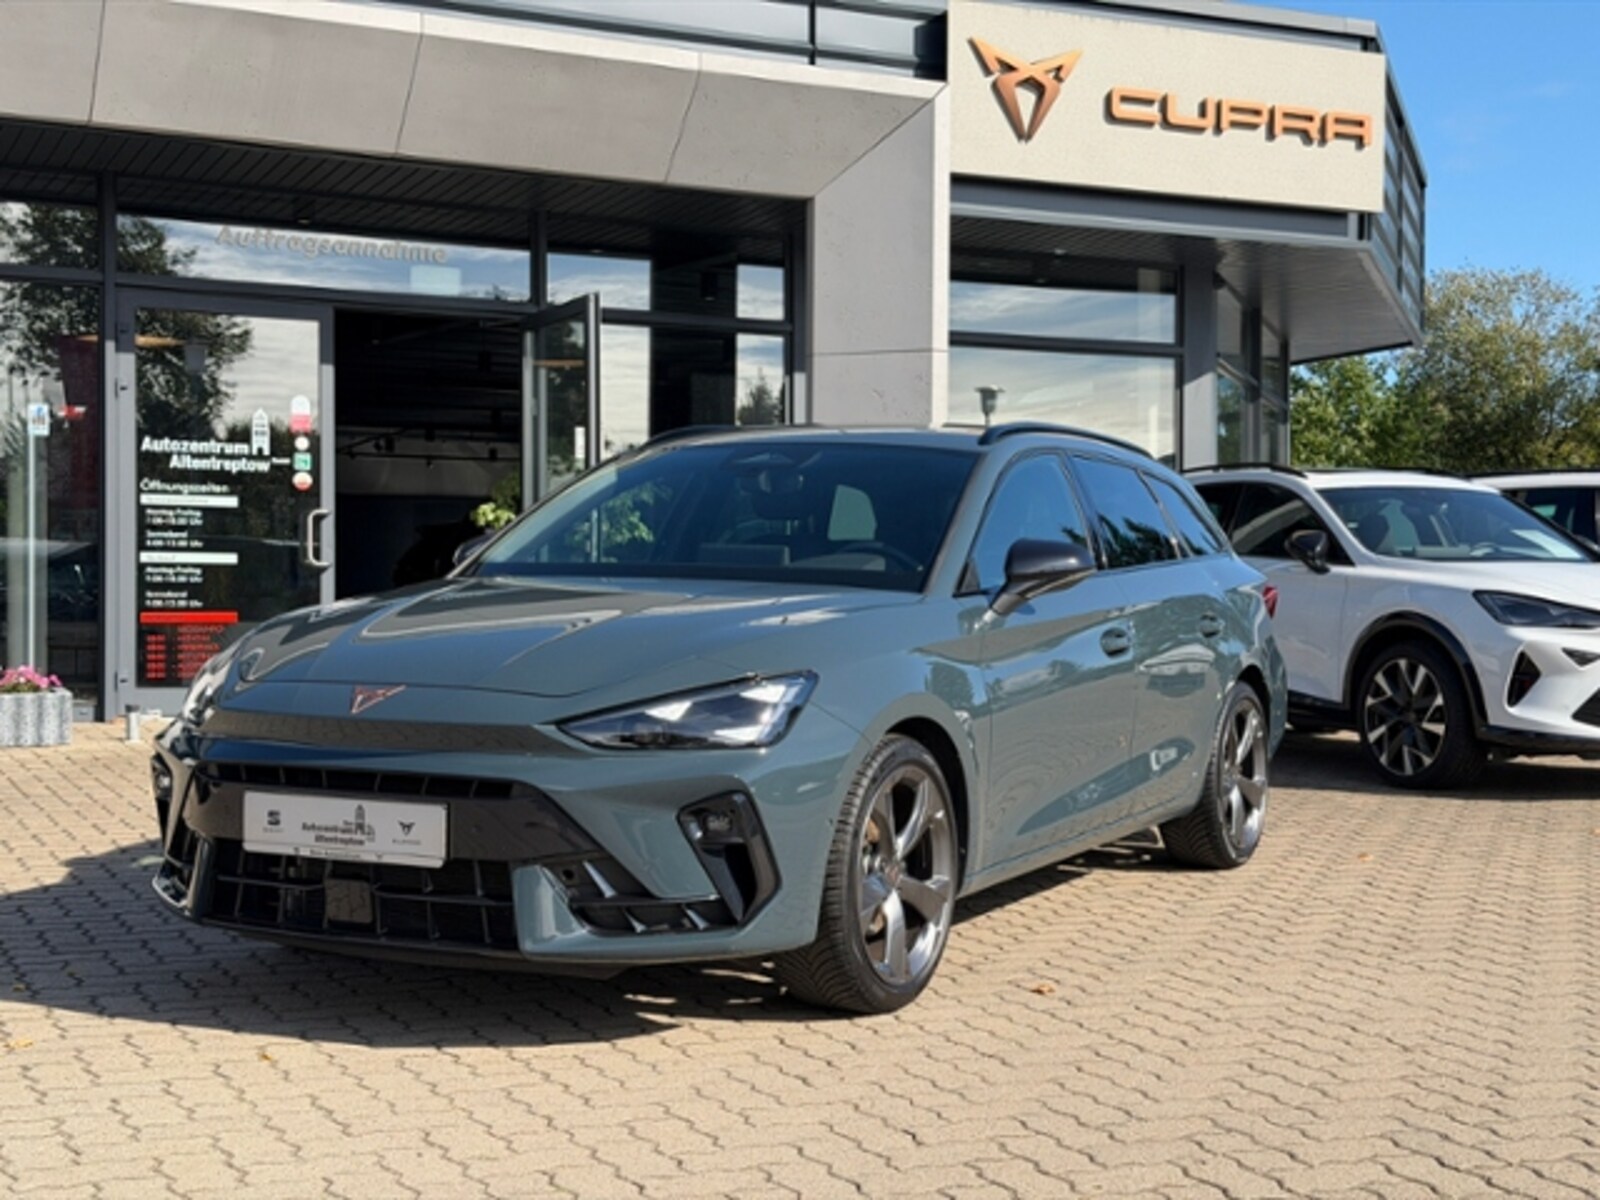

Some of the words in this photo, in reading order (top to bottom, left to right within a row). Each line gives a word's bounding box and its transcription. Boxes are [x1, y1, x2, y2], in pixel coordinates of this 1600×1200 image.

[1105, 87, 1372, 149] CUPRA
[215, 224, 448, 263] Auftragsannahme
[140, 436, 250, 455] Autozentrum
[169, 454, 271, 473] Altentreptow
